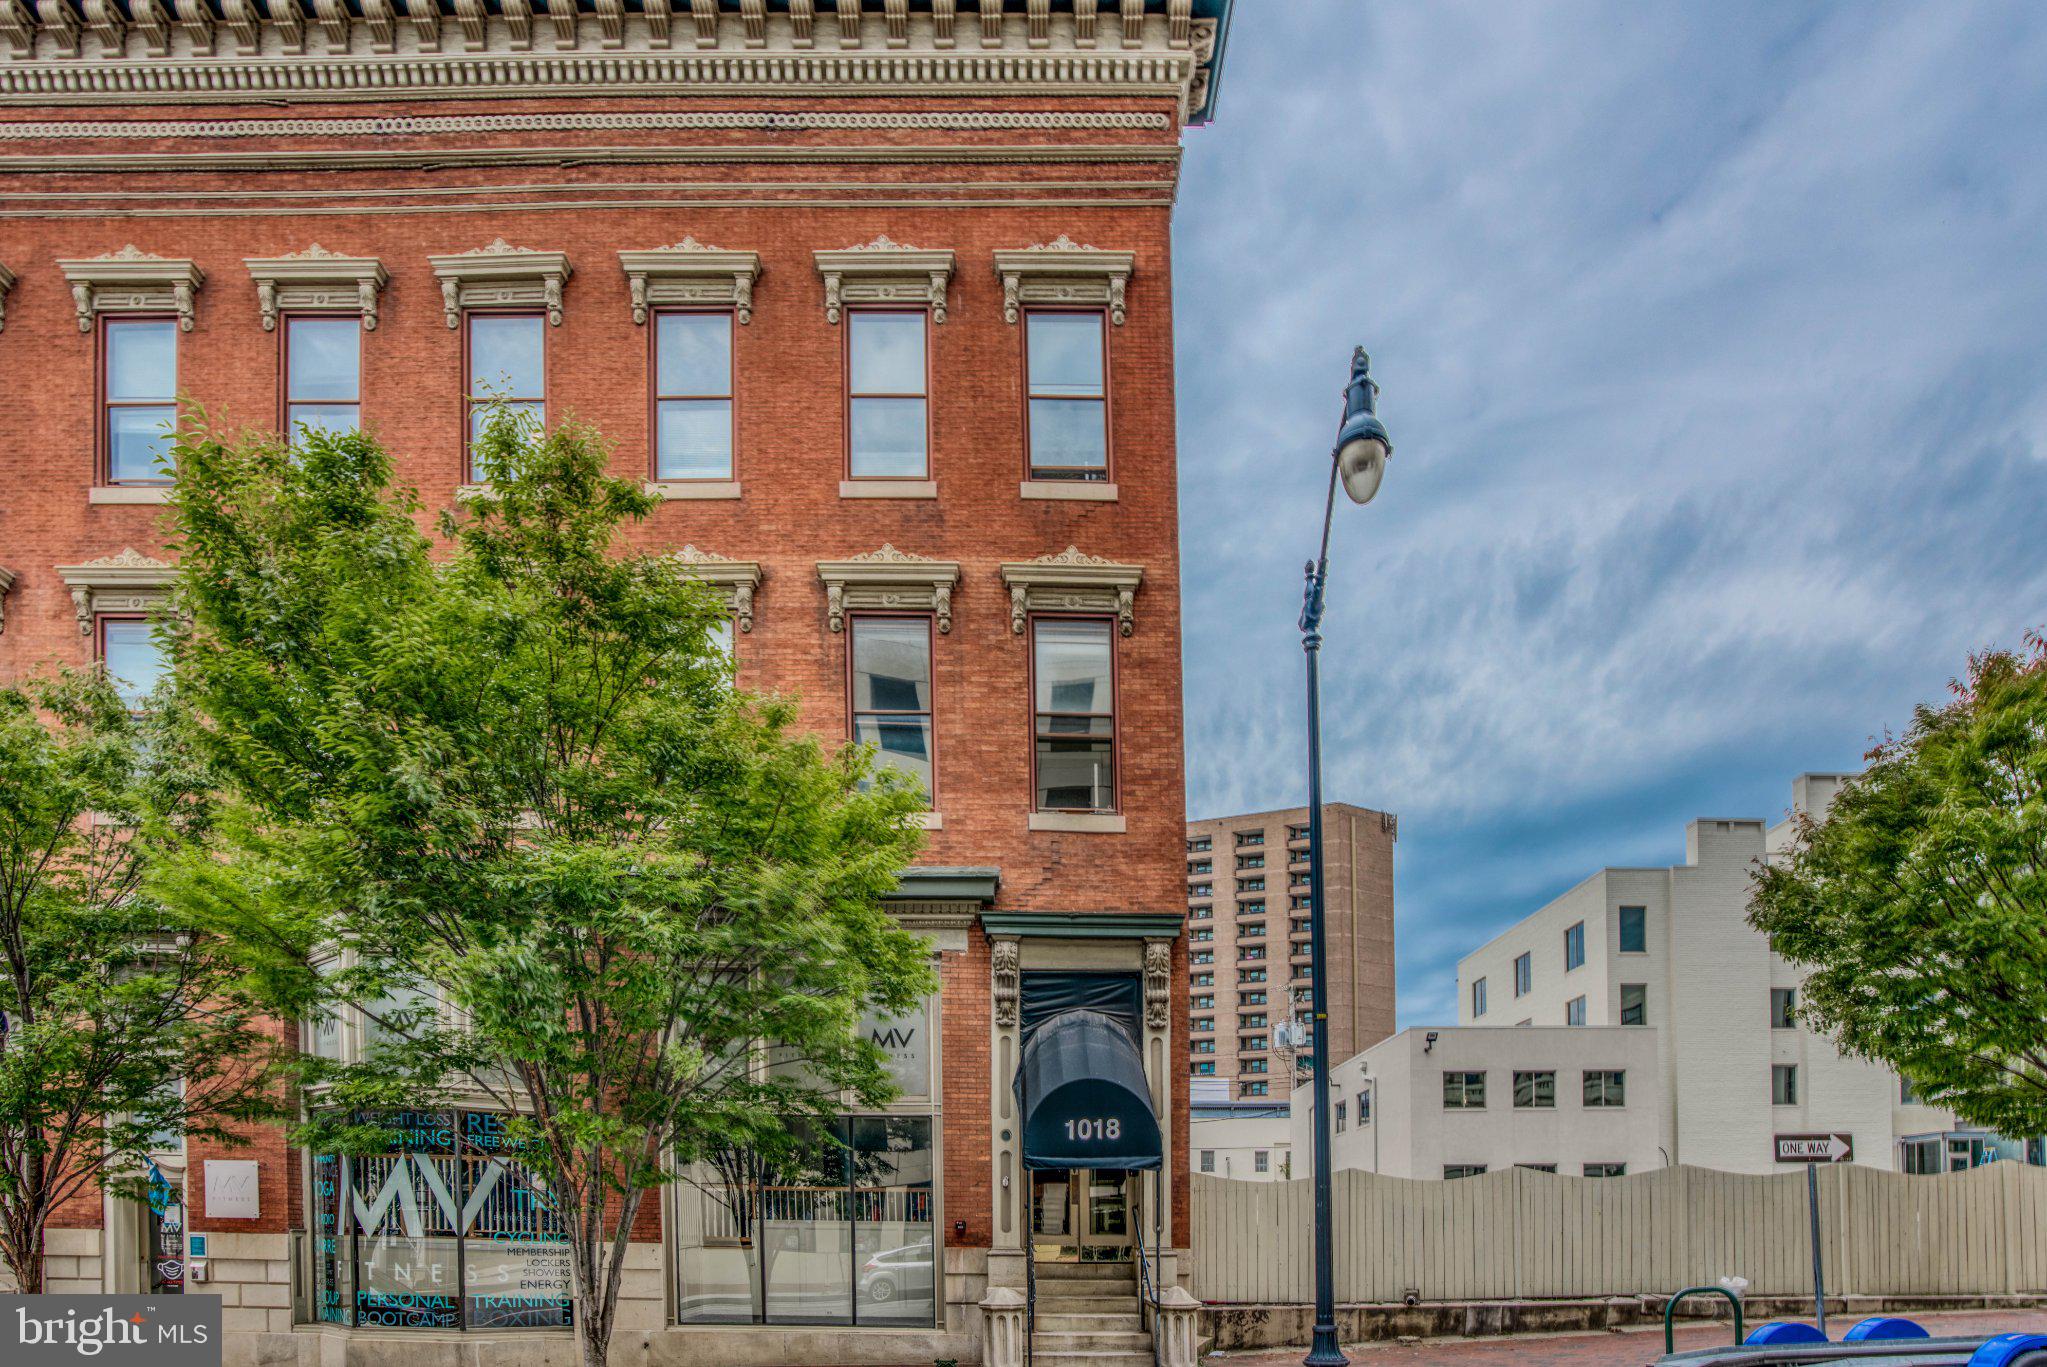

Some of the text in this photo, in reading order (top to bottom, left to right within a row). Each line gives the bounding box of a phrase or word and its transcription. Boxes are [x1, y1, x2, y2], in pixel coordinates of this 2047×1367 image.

[871, 1028, 916, 1049] MV
[416, 1113, 451, 1127] LOSS
[1064, 1118, 1120, 1141] 1018
[1782, 1142, 1829, 1154] ONE WAY
[493, 1231, 569, 1245] CYCLING
[507, 1248, 570, 1257] MEMBERSHIP
[526, 1259, 571, 1267] LOCKERS
[523, 1268, 571, 1277] SHOWERS
[520, 1280, 570, 1290] ENERGY
[357, 1291, 570, 1309] PERSONAL TRAINING
[357, 1311, 455, 1328] BOOTCAMP
[473, 1309, 571, 1328] BOXING
